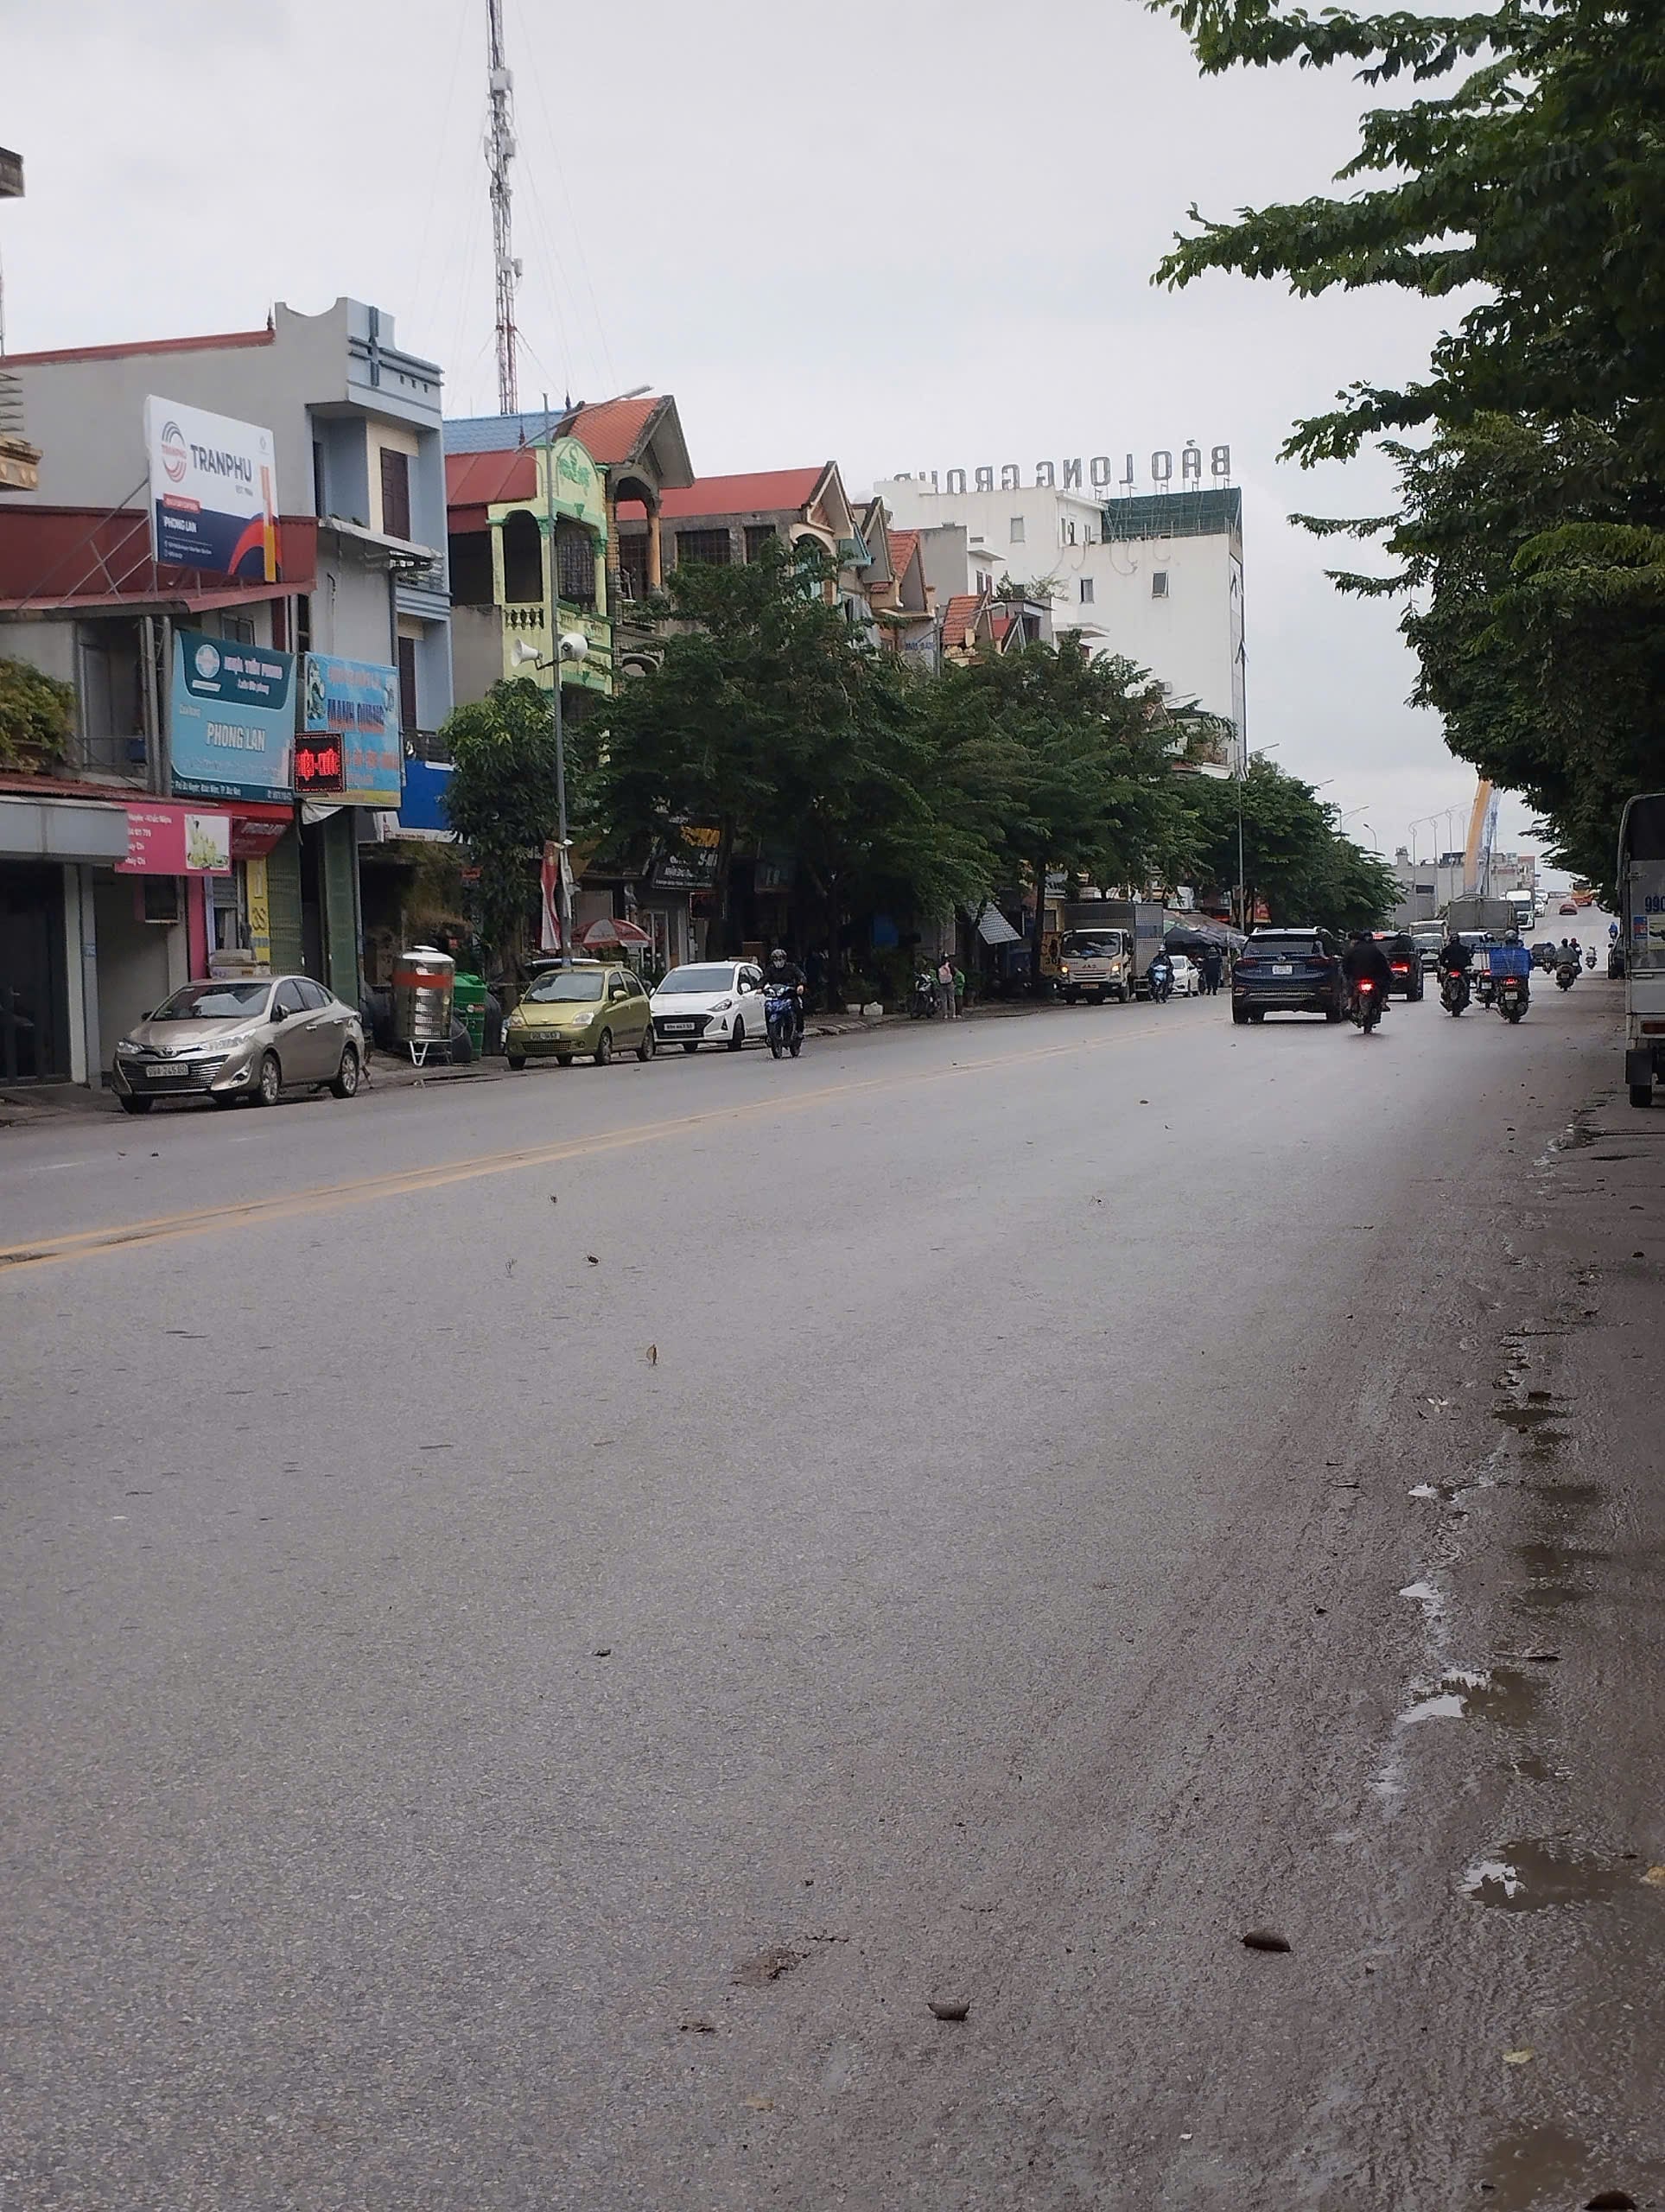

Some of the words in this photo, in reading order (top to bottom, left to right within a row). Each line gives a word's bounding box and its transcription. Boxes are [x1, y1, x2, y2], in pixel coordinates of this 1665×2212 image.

[190, 443, 252, 483] TRANPHU
[206, 721, 244, 750] PHONG
[245, 728, 266, 753] LAN
